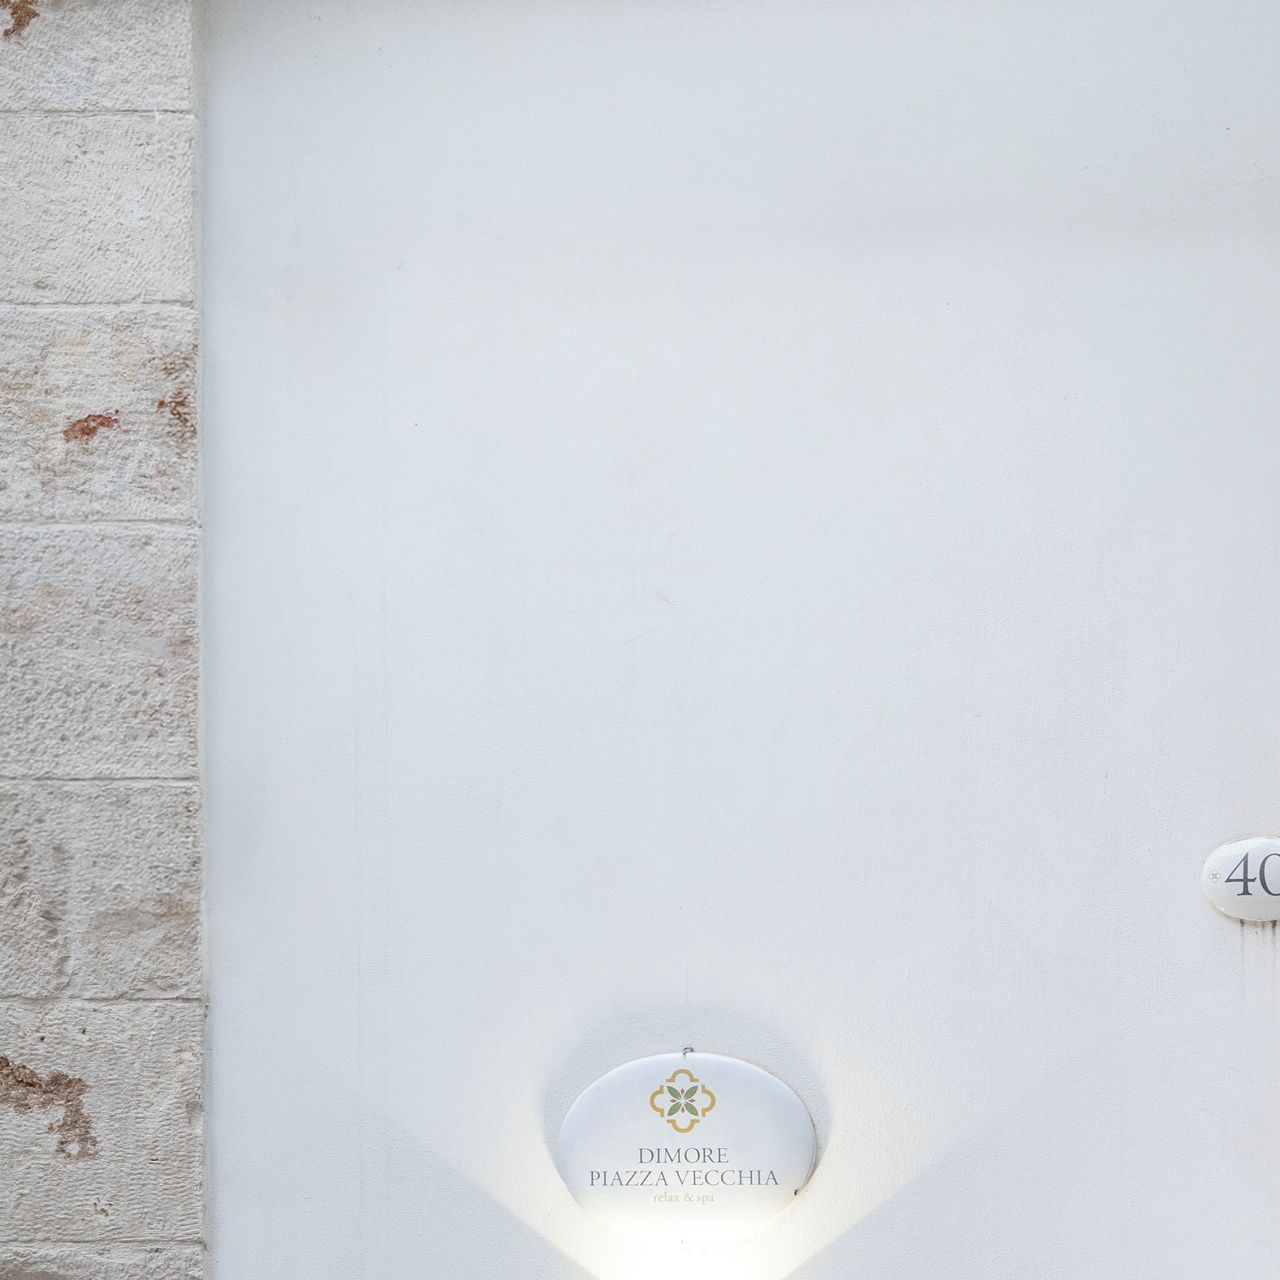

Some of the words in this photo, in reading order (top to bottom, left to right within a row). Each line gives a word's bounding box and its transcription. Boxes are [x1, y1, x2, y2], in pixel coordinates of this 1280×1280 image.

[638, 1147, 729, 1164] DIMORE
[589, 1170, 669, 1187] PIAZZA
[675, 1169, 780, 1186] VECCHIA
[653, 1191, 680, 1202] relax
[683, 1192, 695, 1202] &
[696, 1194, 715, 1205] spa
